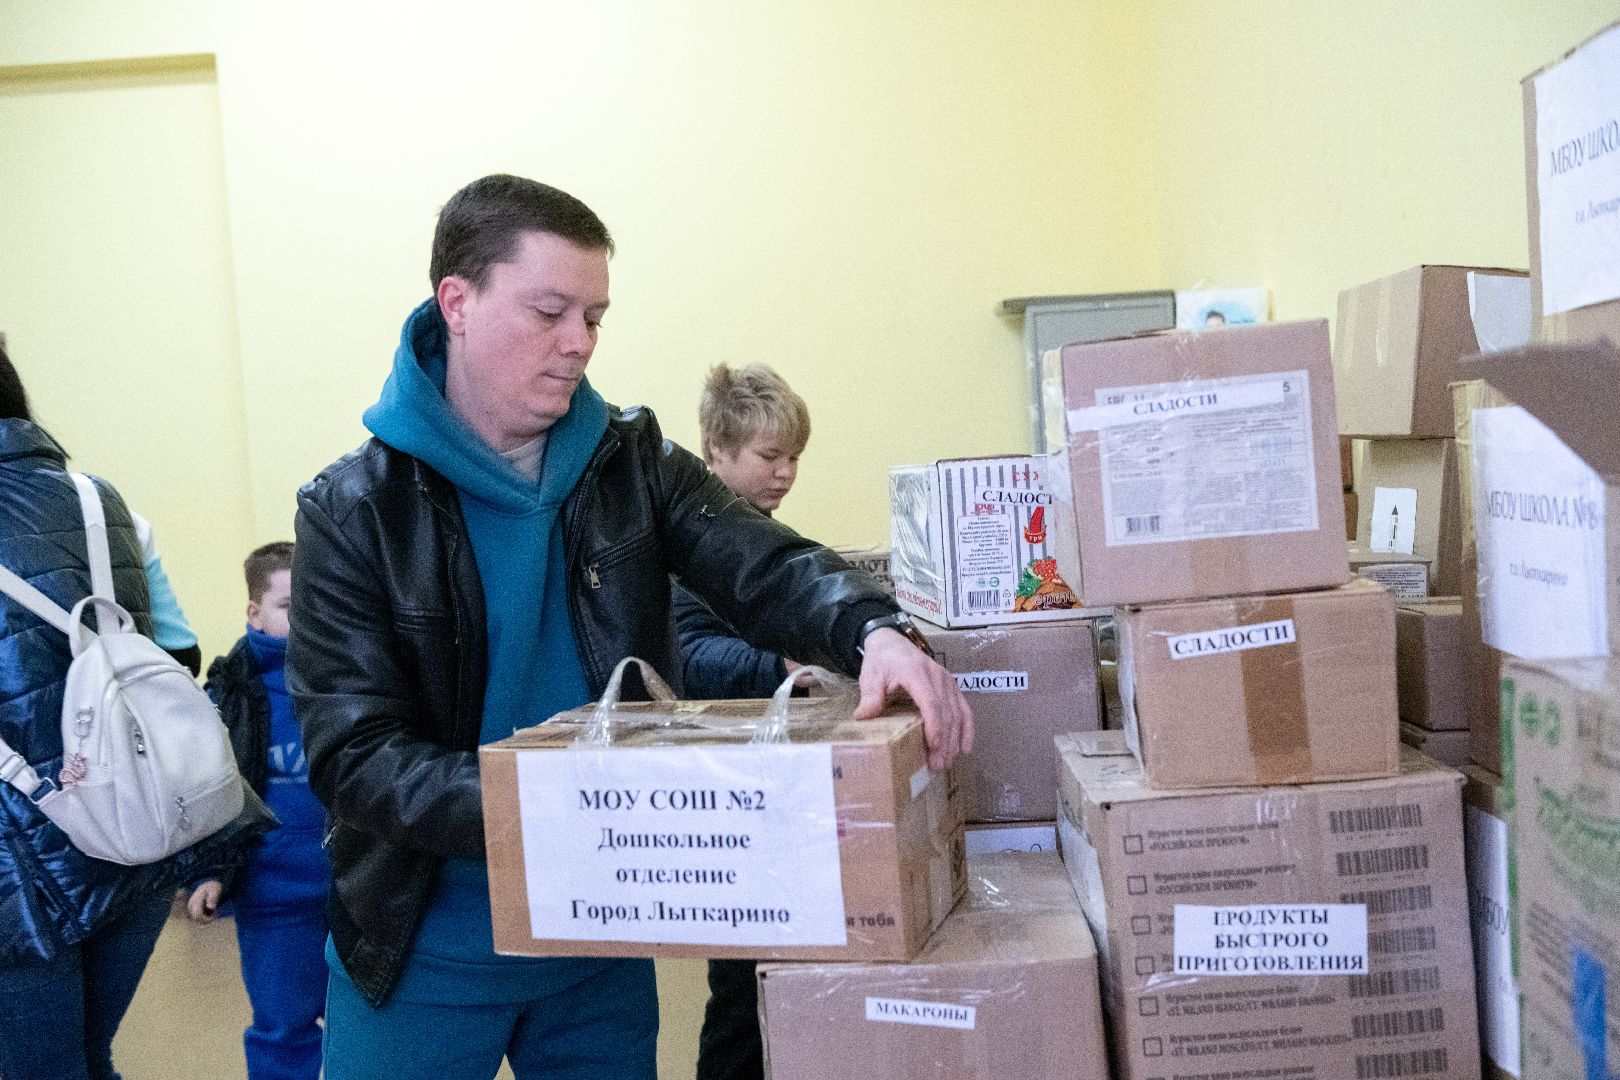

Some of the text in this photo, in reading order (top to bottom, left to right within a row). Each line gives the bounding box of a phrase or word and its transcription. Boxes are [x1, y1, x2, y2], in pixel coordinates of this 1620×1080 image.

[1550, 119, 1620, 176] МБОУ ШКО
[1282, 381, 1291, 393] 5
[1133, 393, 1218, 417] СЛАДОСТИ
[982, 490, 1052, 505] СЛАДОСТ
[1485, 490, 1517, 520] МБОУ
[1519, 492, 1570, 525] ШКОЛА
[1035, 592, 1073, 609] грен
[1174, 623, 1289, 656] СЛАДОСТИ
[955, 675, 1025, 690] АДОСТИ
[578, 789, 766, 811] МОУ СОШ №2
[597, 827, 751, 851] Дошкольное
[616, 867, 737, 886] отделение
[570, 899, 790, 928] Город Лыткарино
[1213, 909, 1329, 927] ПРОДУКТЫ
[1214, 932, 1329, 949] БЫСТРОГО
[1177, 954, 1364, 972] ПРИГОТОВЛЕНИЯ
[875, 1000, 969, 1022] МАКАРОНЫ
